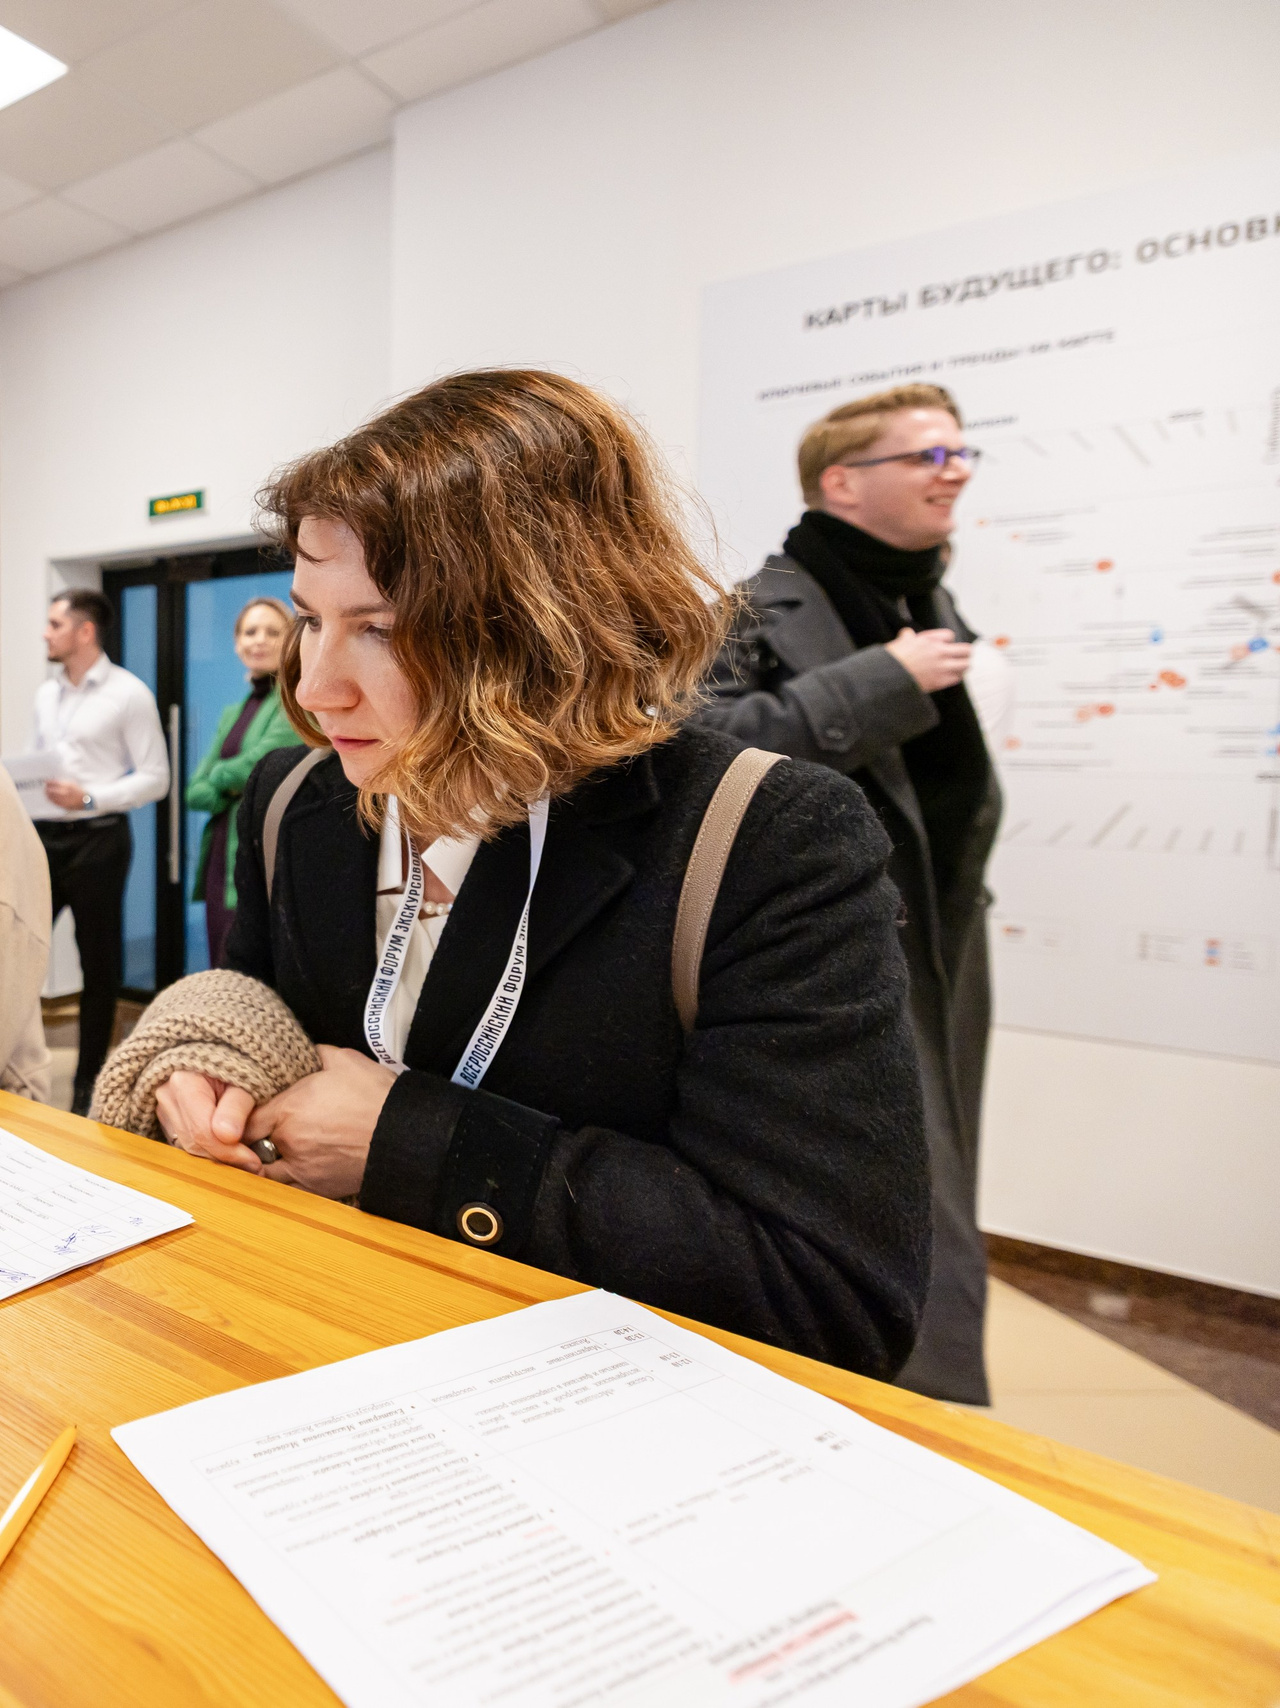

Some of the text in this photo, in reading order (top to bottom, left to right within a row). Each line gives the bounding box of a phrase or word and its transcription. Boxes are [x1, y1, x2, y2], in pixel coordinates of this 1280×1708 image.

[803, 290, 909, 332] КАРТЫ
[919, 248, 1122, 310] БУДУЩЕГО:
[380, 934, 406, 977] ФОРУМ
[368, 978, 396, 1066] ВСЕРОССИЙСКИЙ
[459, 994, 515, 1085] ВСЕРОССИЙСКИЙ
[503, 945, 526, 993] ФОРУМ
